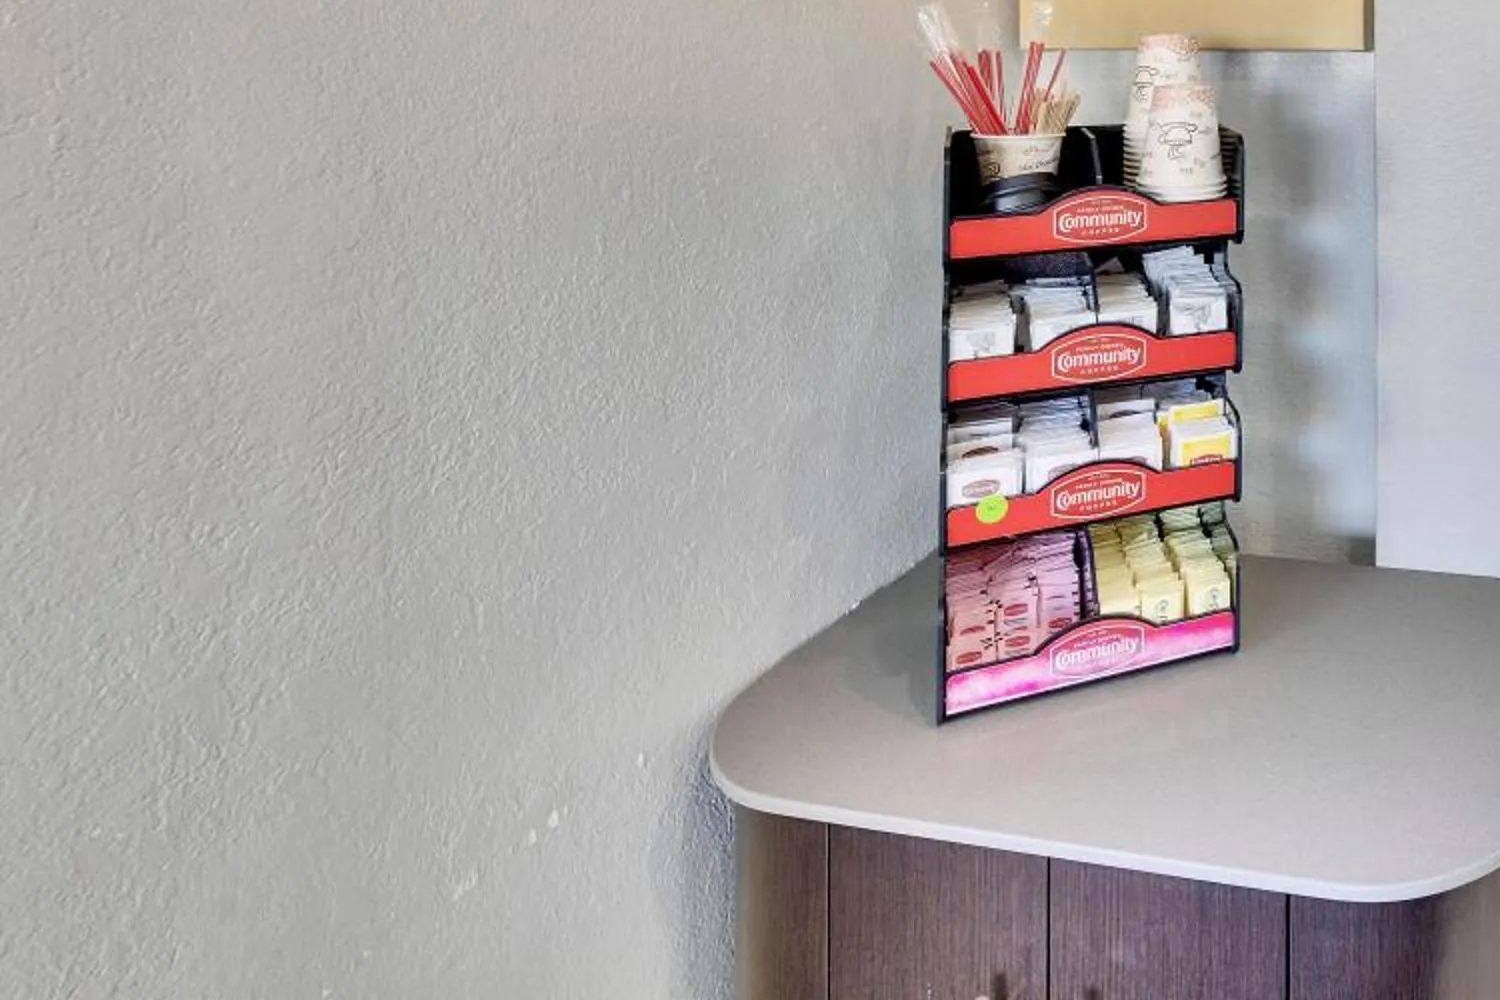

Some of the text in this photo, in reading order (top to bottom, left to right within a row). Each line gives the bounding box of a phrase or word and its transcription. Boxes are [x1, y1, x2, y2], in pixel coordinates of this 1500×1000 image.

[1058, 208, 1143, 233] Community
[1056, 346, 1141, 373] Community
[1055, 480, 1141, 511] Community
[1054, 634, 1140, 671] Community
